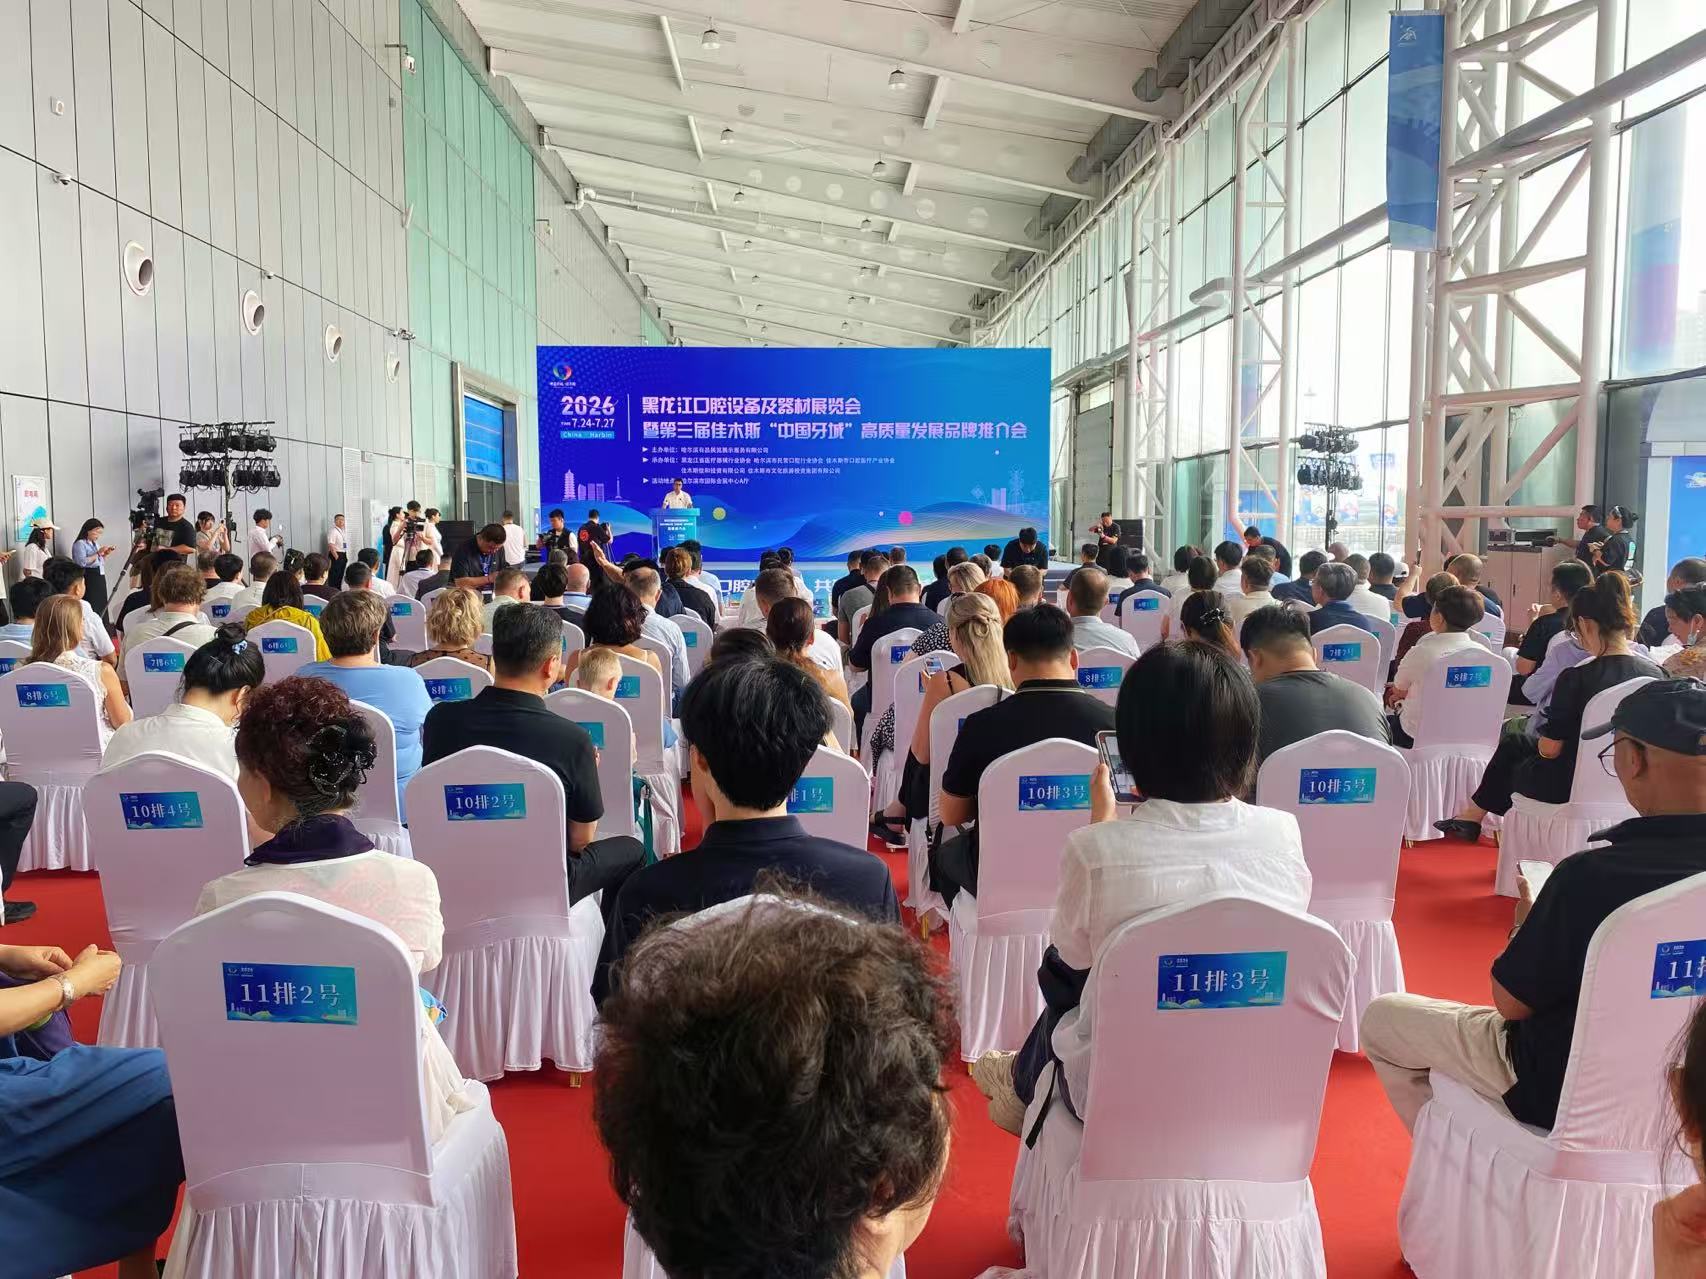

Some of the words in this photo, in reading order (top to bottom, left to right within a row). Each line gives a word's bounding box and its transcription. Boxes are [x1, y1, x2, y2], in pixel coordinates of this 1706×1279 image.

[561, 396, 616, 415] 2026
[642, 396, 861, 415] 黑龙江口腔设备及器材展览会
[572, 418, 615, 428] 7.24-7.27
[563, 431, 582, 439] China
[590, 431, 613, 439] Harbin
[25, 689, 59, 702] 8排6号
[1028, 785, 1086, 800] 10排3号
[1310, 778, 1366, 793] 10排5号
[456, 794, 516, 809] 10排2号
[790, 787, 824, 803] 排1号
[131, 802, 192, 818] 10排4号
[1173, 968, 1269, 992] 11排3号
[241, 981, 340, 1007] 11排2号
